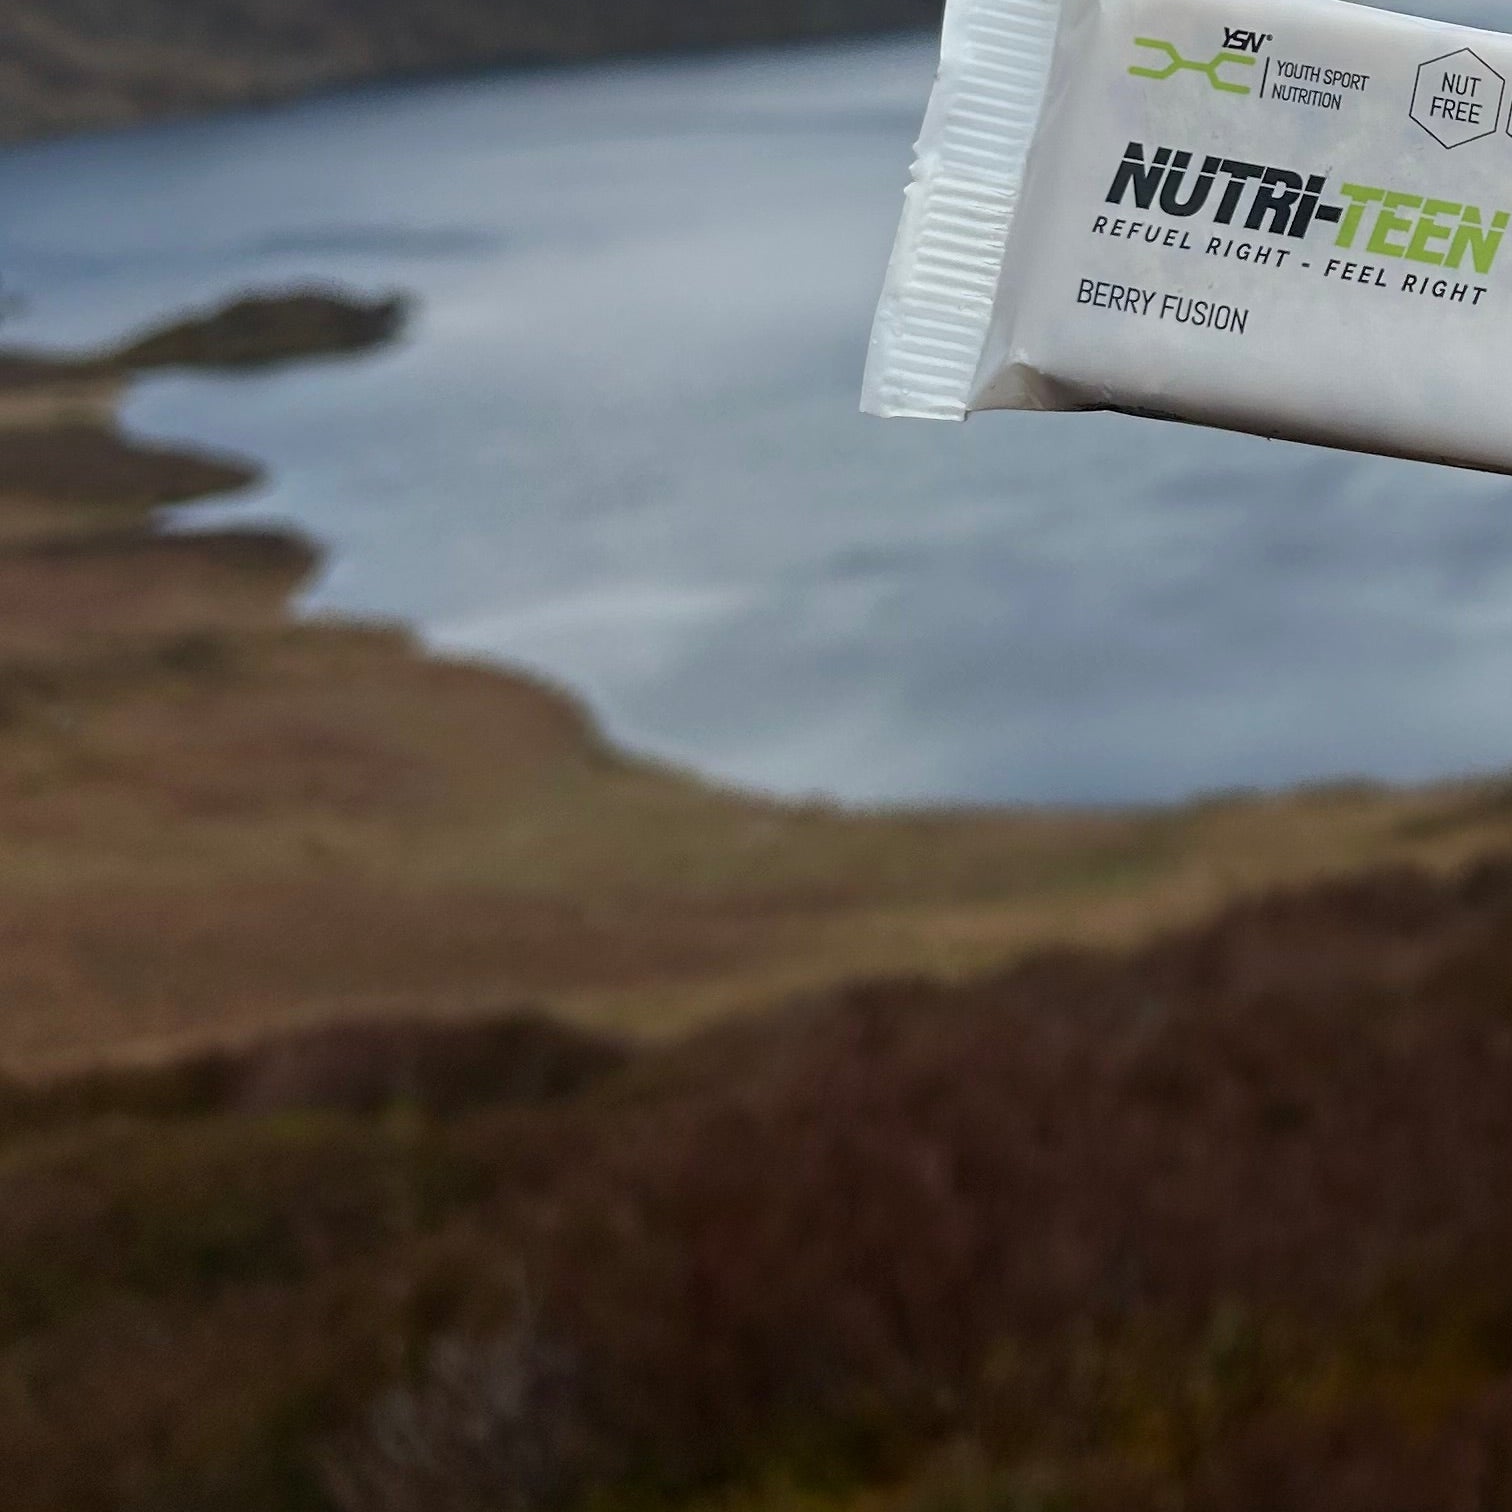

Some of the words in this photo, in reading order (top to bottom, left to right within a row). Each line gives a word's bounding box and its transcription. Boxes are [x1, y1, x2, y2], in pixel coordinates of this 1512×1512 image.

[1277, 60, 1320, 82] YOUTH
[1323, 69, 1370, 91] SPORT
[1441, 72, 1481, 98] NUT
[1272, 83, 1342, 110] NUTRITION
[1430, 96, 1482, 125] FREE
[1092, 216, 1192, 250] REFUEL
[1205, 237, 1291, 269] RIGHT
[1324, 259, 1387, 287] FEEL
[1401, 274, 1488, 306] RIGHT
[1077, 279, 1157, 316] BERRY
[1159, 294, 1249, 334] FUSION
